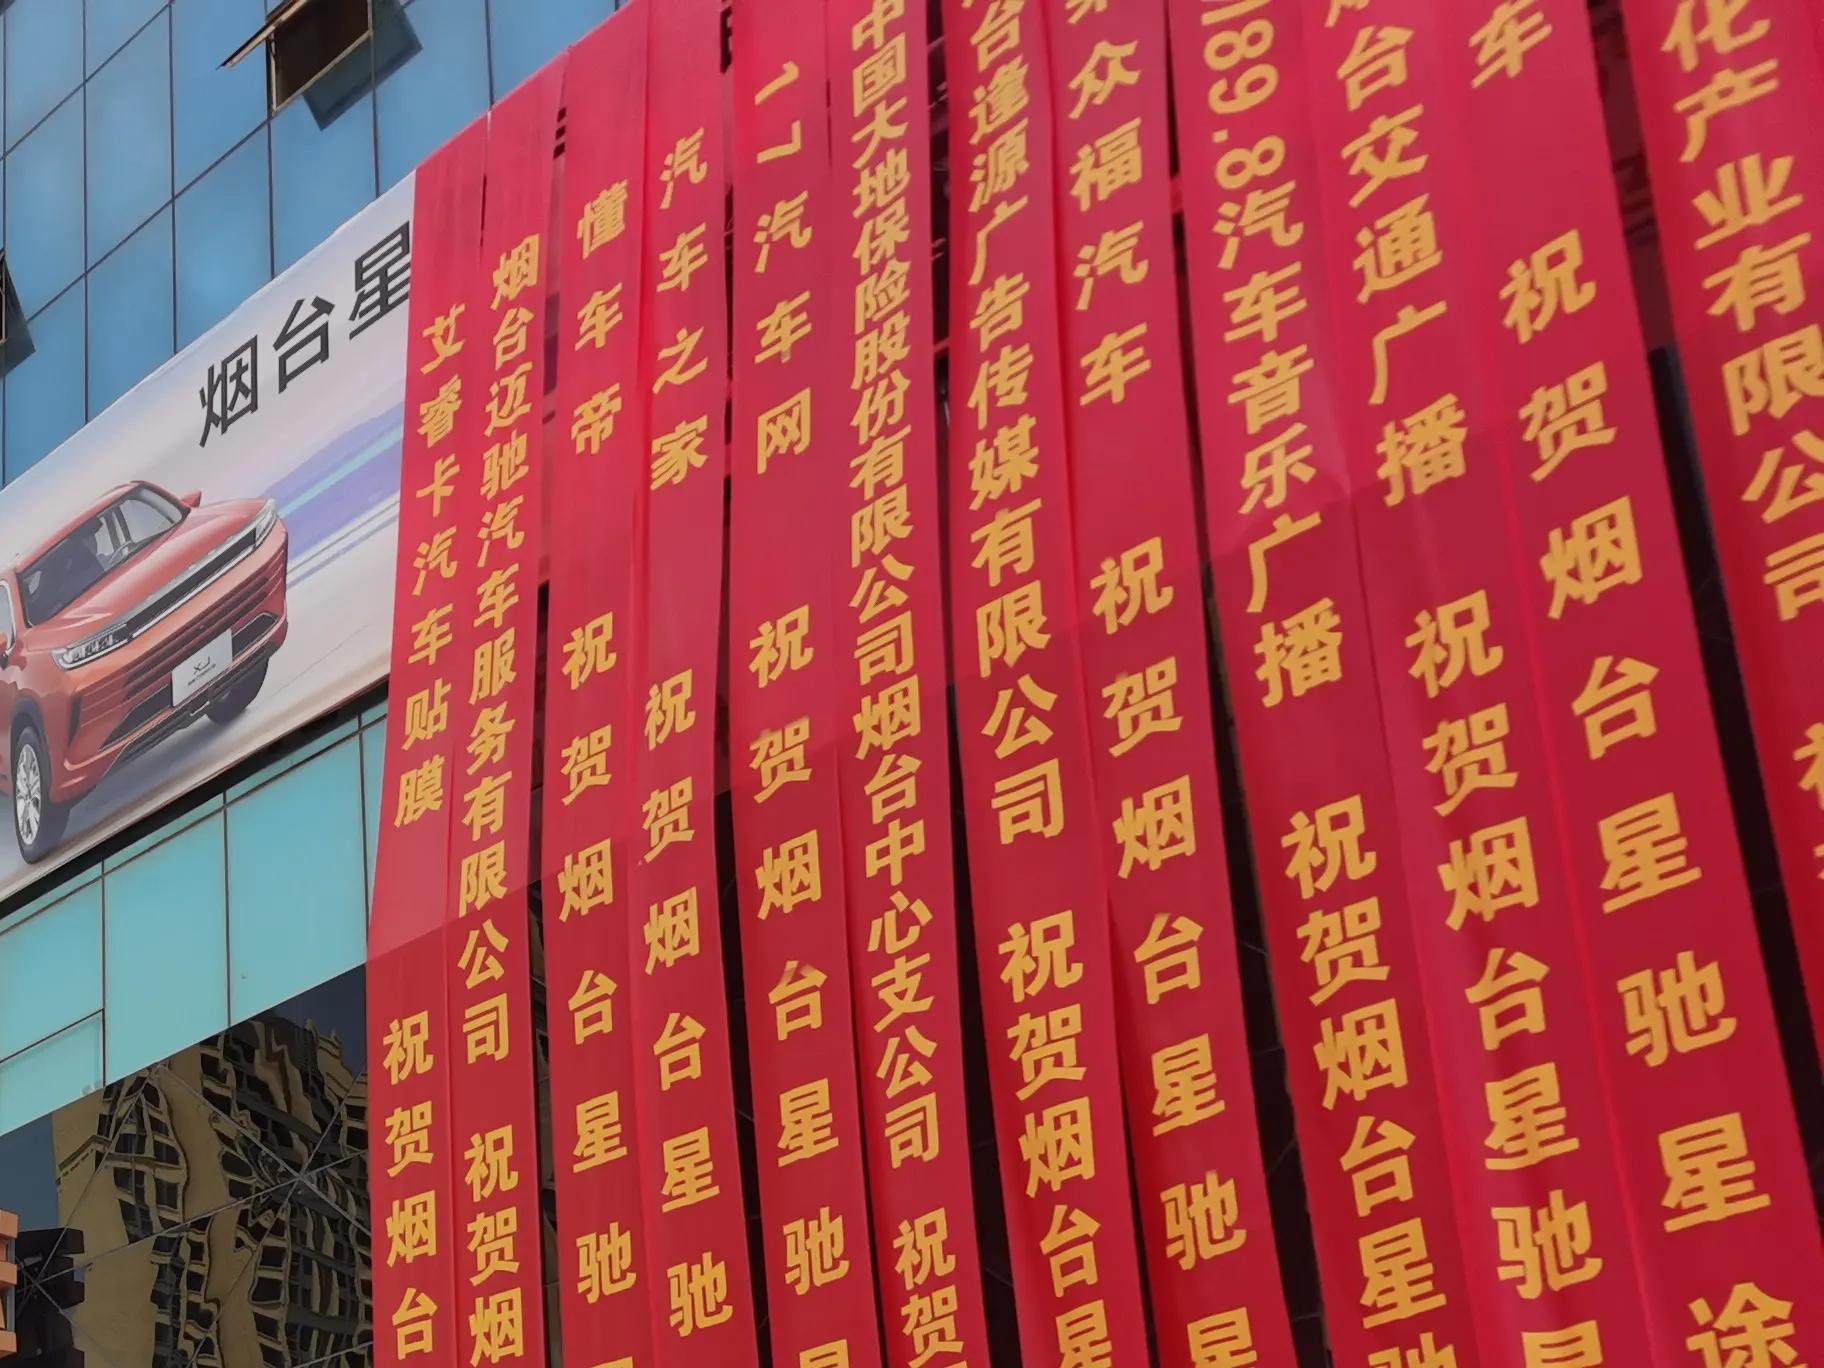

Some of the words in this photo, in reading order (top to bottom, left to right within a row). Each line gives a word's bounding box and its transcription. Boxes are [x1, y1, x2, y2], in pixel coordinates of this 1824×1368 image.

[570, 179, 629, 455] 懂车帝
[650, 127, 708, 491] 汽车之家
[1066, 0, 1152, 406] 众福汽车
[1324, 0, 1467, 507] 台交通广播
[393, 304, 466, 828] 艾睿卡汽车贴膜
